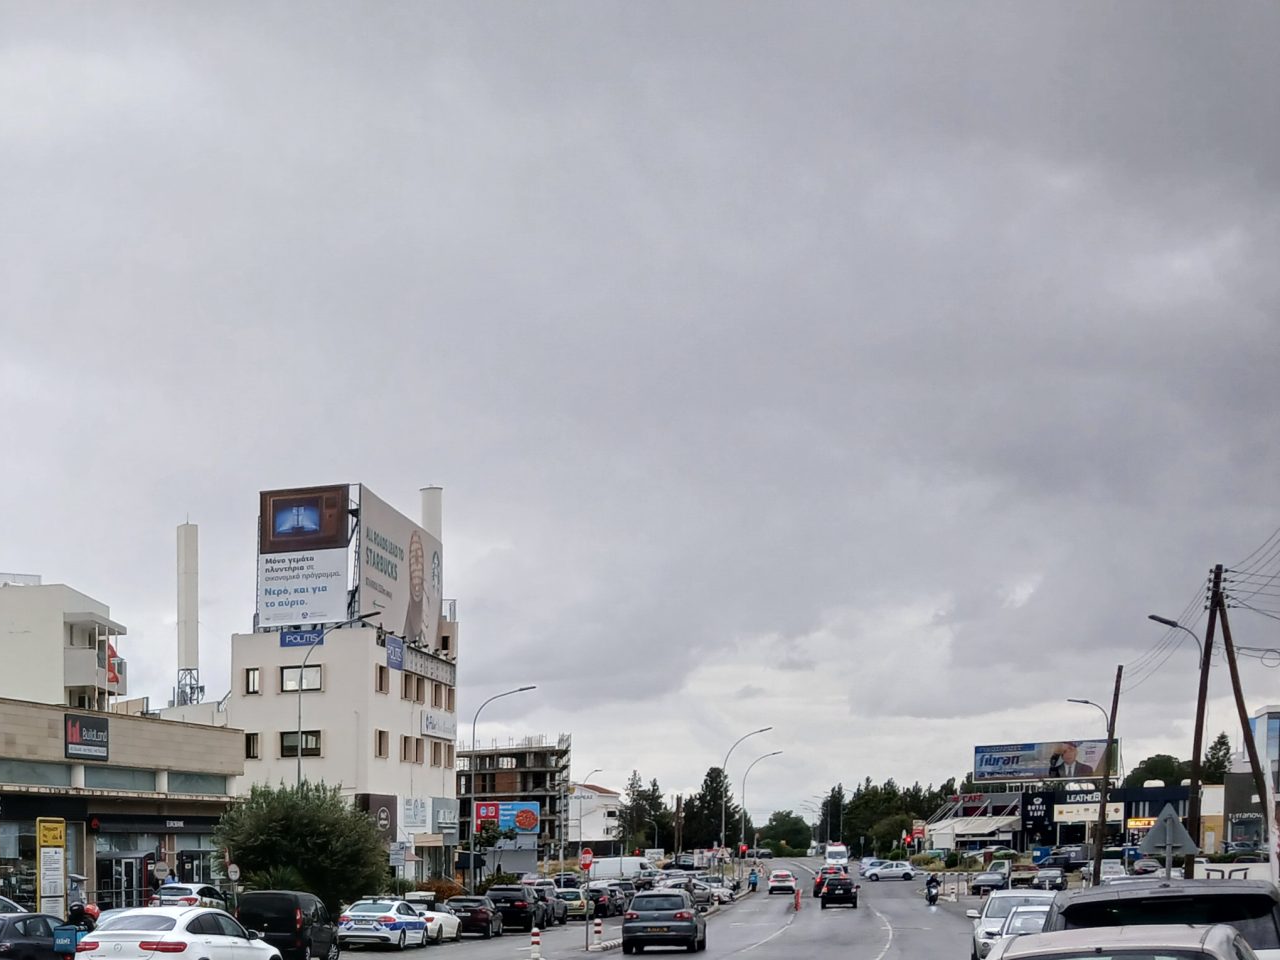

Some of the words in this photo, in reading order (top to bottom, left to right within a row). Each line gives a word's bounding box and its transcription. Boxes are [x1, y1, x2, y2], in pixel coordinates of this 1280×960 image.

[365, 545, 398, 581] STARBUCKS
[264, 586, 291, 597] Νερό,
[312, 585, 327, 595] για
[278, 598, 308, 608] αύριο.
